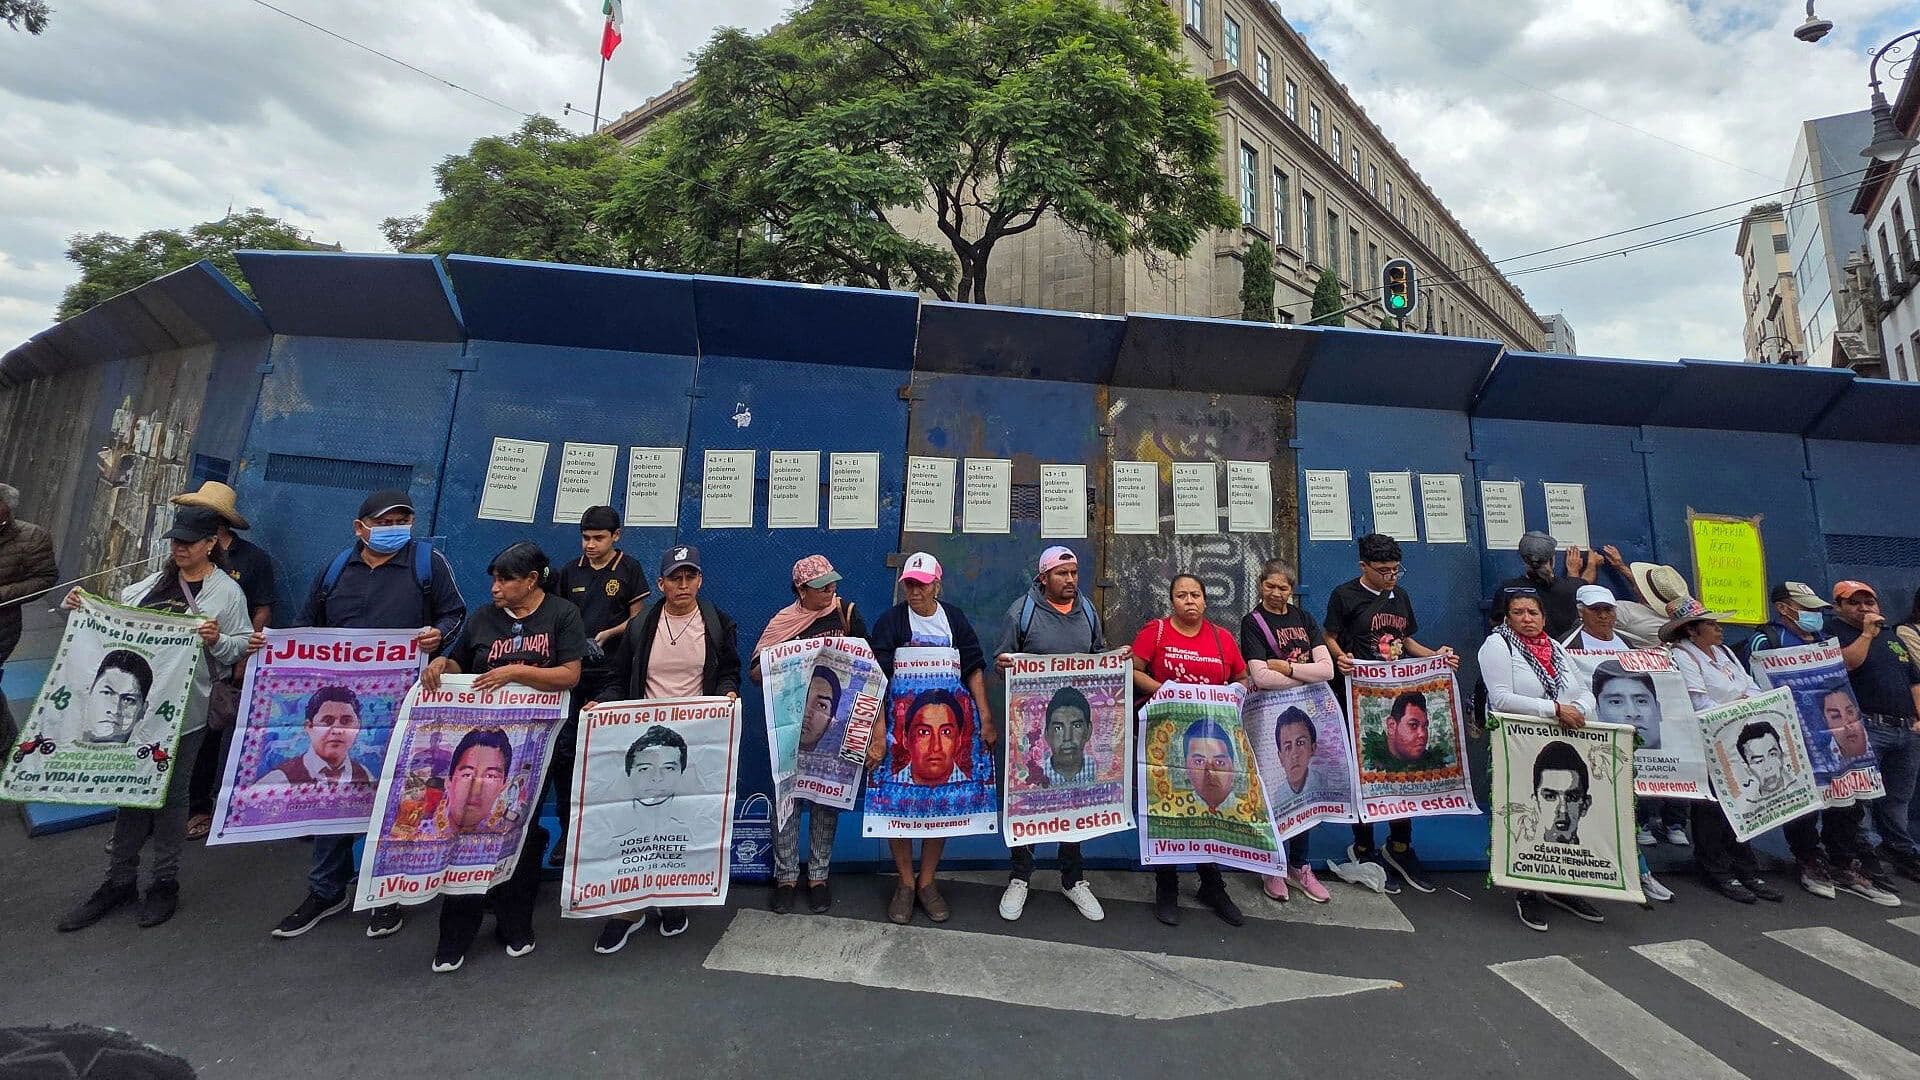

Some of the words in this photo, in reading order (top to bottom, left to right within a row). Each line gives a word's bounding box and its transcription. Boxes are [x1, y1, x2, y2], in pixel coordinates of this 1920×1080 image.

[493, 464, 521, 472] encubre
[495, 454, 525, 464] gobierno
[490, 482, 518, 491] culpable
[80, 618, 106, 634] ¡Vivo
[109, 628, 120, 638] se
[122, 630, 134, 642] lo
[136, 632, 194, 646] llevaron!
[264, 639, 418, 664] ¡Justicia!
[770, 644, 802, 663] ¡Vivo
[806, 641, 820, 651] se
[824, 636, 833, 647] lo
[1012, 659, 1046, 676] ¡Nos
[1050, 657, 1094, 672] faltan
[1099, 655, 1123, 669] 43!
[1763, 654, 1797, 670] ¡Vivo
[1799, 654, 1812, 664] se
[1812, 650, 1823, 662] lo
[1391, 664, 1427, 678] faltan
[415, 689, 453, 706] ¡Vivo
[458, 692, 476, 701] se
[480, 690, 492, 704] lo
[498, 690, 560, 706] llevaron!
[1178, 690, 1192, 700] se
[1196, 688, 1206, 700] lo
[854, 696, 880, 718] NOS
[593, 711, 630, 728] ¡Vivo
[634, 712, 650, 724] se
[654, 708, 667, 722] lo
[671, 706, 730, 721] llevaron!
[846, 717, 872, 752] FALTAN
[1507, 724, 1534, 736] ¡Vivo
[1536, 727, 1548, 736] se
[1548, 725, 1560, 737] lo
[1561, 728, 1608, 742] llevaron!
[51, 752, 90, 762] JORGE
[44, 772, 75, 782] VIDA
[78, 772, 90, 783] lo
[92, 774, 152, 786] queremos!
[1648, 780, 1698, 793] queremos!
[1366, 800, 1418, 817] Dónde
[1421, 794, 1466, 810] están
[888, 820, 910, 830] ¡Vivo
[914, 820, 922, 828] lo
[924, 818, 970, 830] queremos!
[1012, 817, 1070, 838] Dónde
[1076, 810, 1122, 830] están
[1287, 816, 1294, 828] lo
[1296, 804, 1344, 824] queremos!
[621, 844, 687, 856] NAVARRETE
[622, 853, 682, 864] GONZÁLEZ
[1155, 840, 1185, 855] ¡Vivo
[1189, 841, 1200, 852] lo
[1204, 843, 1271, 863] queremos!
[1562, 847, 1594, 858] MANUEL
[618, 866, 644, 876] EDAD
[661, 860, 686, 870] AÑOS
[1513, 862, 1534, 873] ¡Con
[1534, 864, 1557, 876] VIDA
[1558, 866, 1566, 876] lo
[1568, 869, 1618, 881] queremos!
[1562, 857, 1611, 868] HERNÁNDEZ
[379, 876, 420, 898] ¡Vivo
[425, 875, 440, 891] lo
[580, 883, 606, 902] ¡Con
[610, 876, 640, 895] VIDA
[642, 873, 653, 889] lo
[656, 871, 714, 890] queremos!
